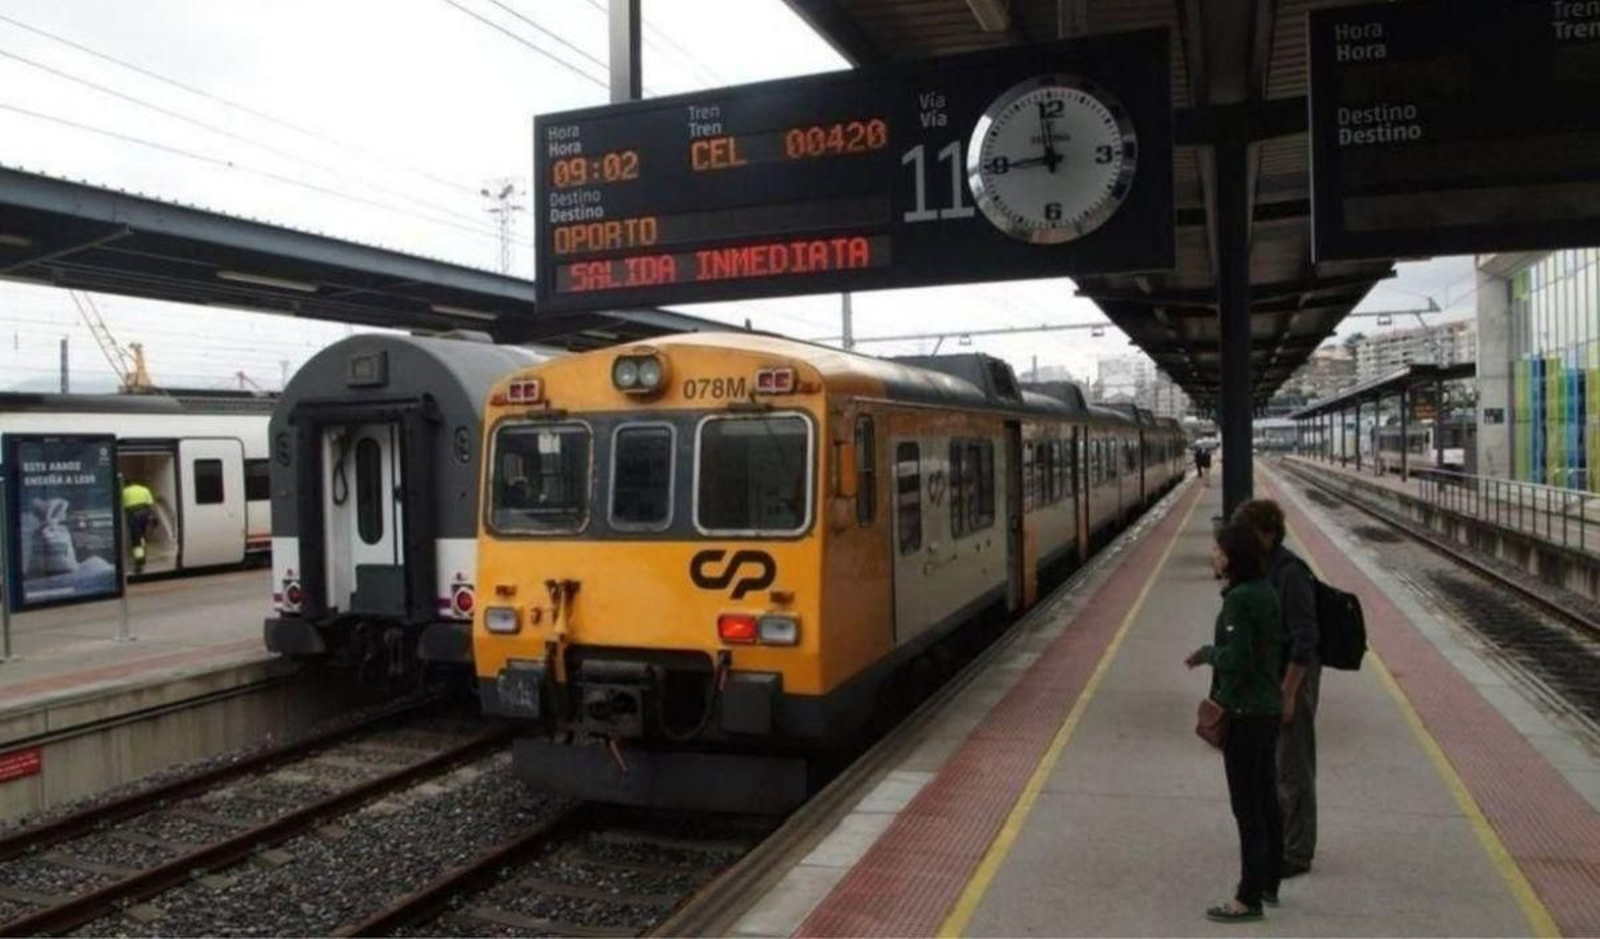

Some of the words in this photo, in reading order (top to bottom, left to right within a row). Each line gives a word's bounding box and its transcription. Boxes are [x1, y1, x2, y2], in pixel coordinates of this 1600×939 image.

[1552, 0, 1600, 17] Tren
[1335, 22, 1383, 40] Hora
[1551, 20, 1600, 39] Tren
[1336, 43, 1387, 62] Hora
[688, 106, 721, 120] Tren
[1338, 104, 1416, 125] Destino
[548, 125, 580, 141] Hora
[688, 122, 722, 137] Tren
[1339, 124, 1421, 146] Destino
[549, 141, 582, 156] Hora
[691, 137, 746, 171] CEL
[785, 119, 887, 160] 00420
[1096, 145, 1112, 164] 3
[553, 151, 639, 188] 09:02
[901, 141, 975, 222] 11
[549, 190, 601, 206] Destino
[551, 205, 604, 223] Destino
[1045, 203, 1062, 221] 6
[554, 217, 658, 254] OPORTO
[569, 255, 676, 292] SALIDA
[696, 237, 869, 281] INMEDIATA
[683, 378, 746, 400] 078M
